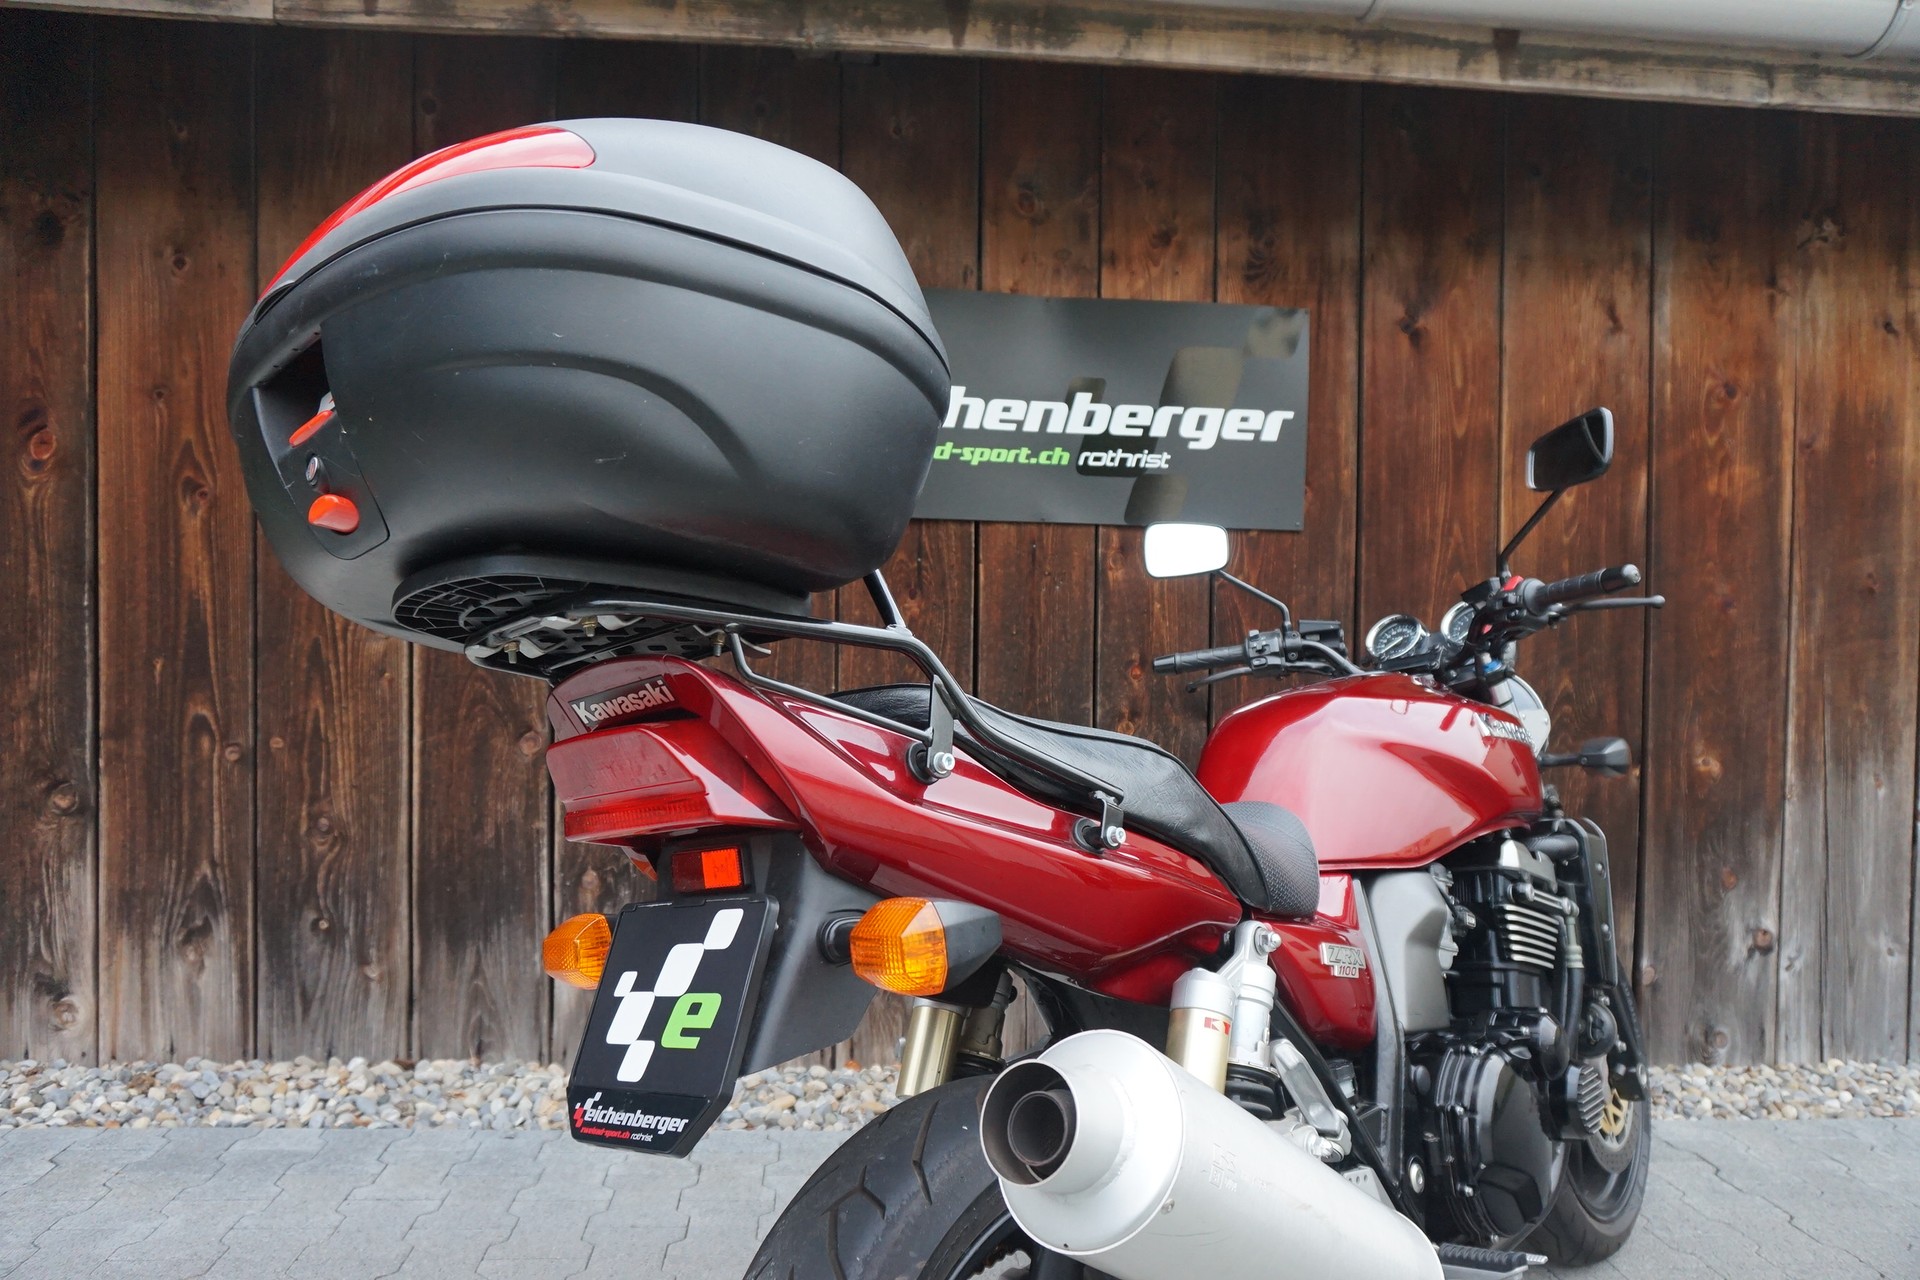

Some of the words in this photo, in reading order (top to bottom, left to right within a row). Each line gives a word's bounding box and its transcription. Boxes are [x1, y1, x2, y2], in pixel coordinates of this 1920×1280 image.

[942, 385, 1294, 450] henberger
[933, 441, 1070, 466] d-sport.ch
[1077, 448, 1171, 469] rothrist
[571, 679, 675, 724] Kawasaki
[1328, 945, 1364, 967] ZRX
[1339, 965, 1357, 976] 1100
[584, 1105, 689, 1135] eichenberger
